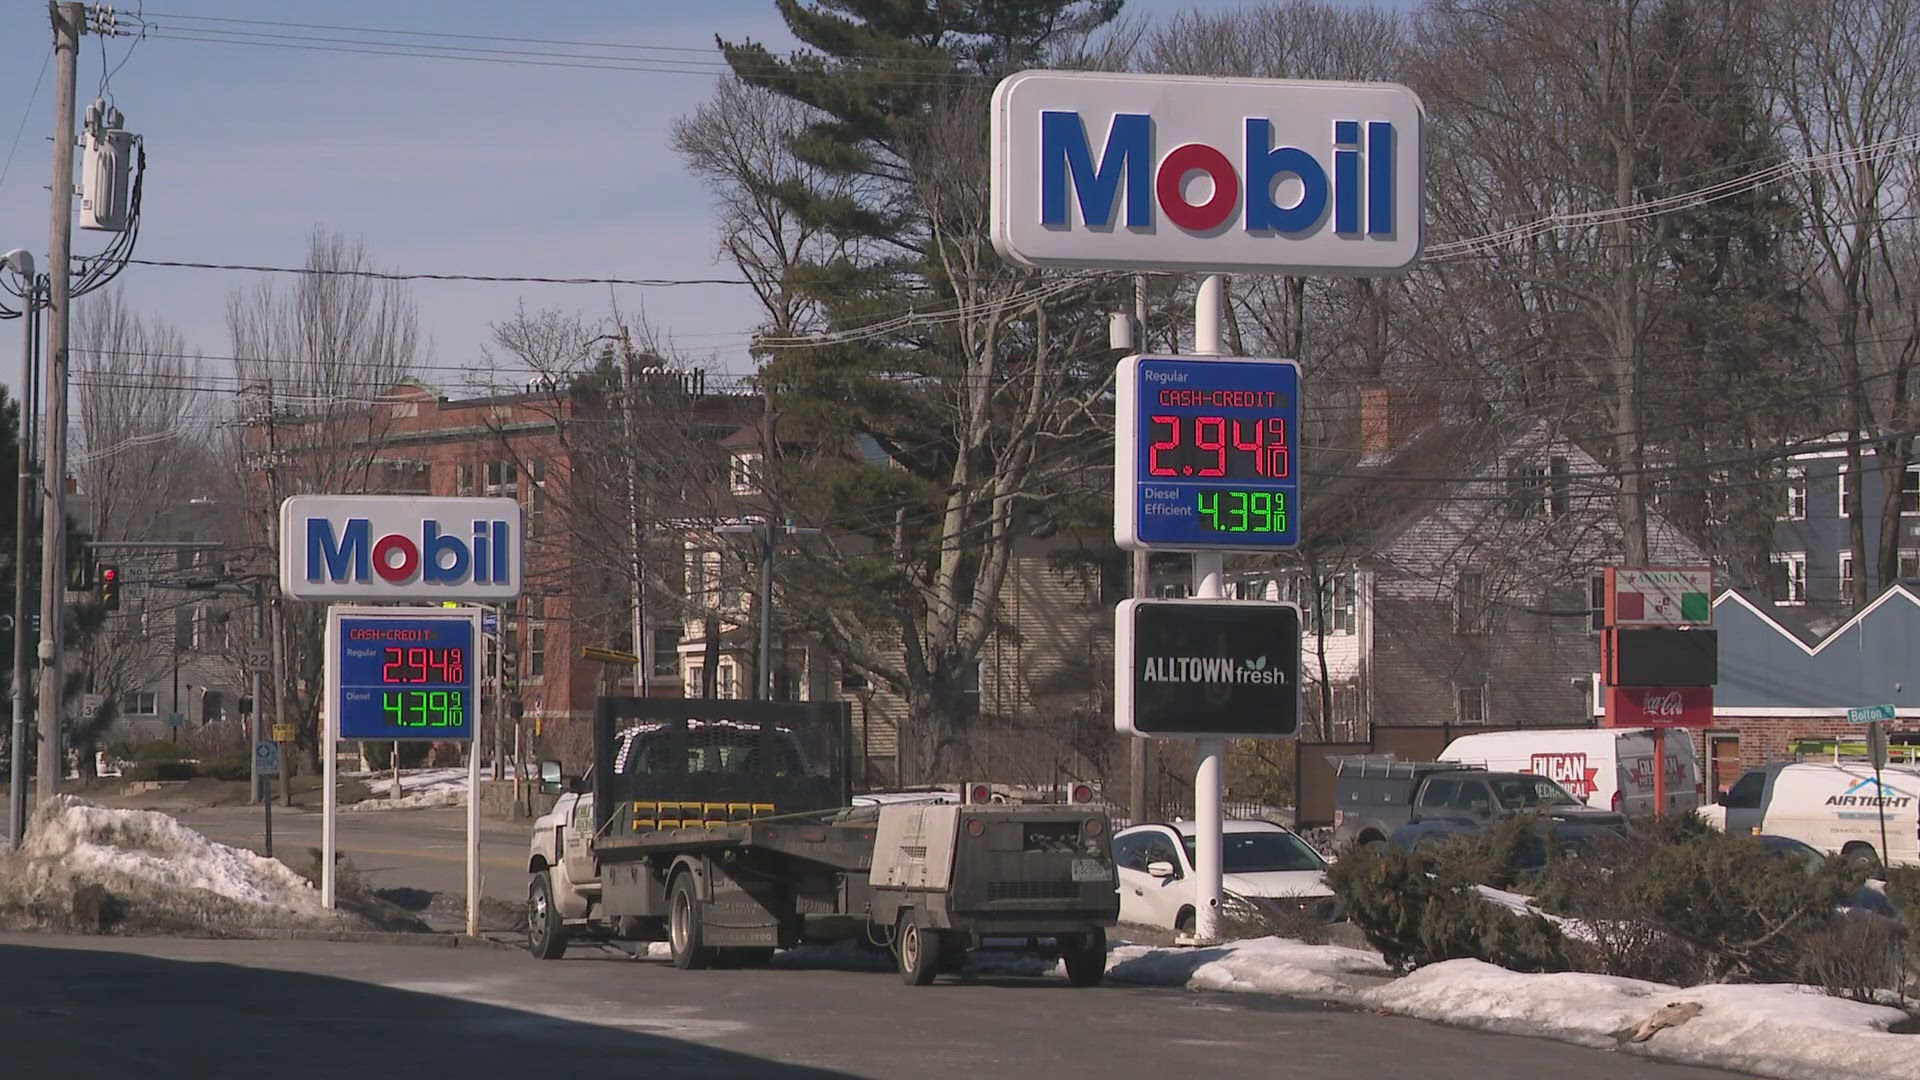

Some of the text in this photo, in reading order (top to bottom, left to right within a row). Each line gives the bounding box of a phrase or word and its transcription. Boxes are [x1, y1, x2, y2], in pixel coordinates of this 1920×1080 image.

[1039, 110, 1397, 240] Mobil
[1145, 370, 1188, 384] Regular
[1159, 390, 1275, 407] CASH-CREDIT
[1145, 489, 1179, 499] Diesel
[1145, 504, 1192, 516] Efficient
[306, 517, 510, 586] Mobil
[350, 629, 431, 641] CASH-CREDIT
[347, 649, 376, 658] Regular
[251, 655, 268, 667] 22
[1144, 657, 1285, 685] ALLTOWN fresh
[346, 692, 370, 701] Diesel
[1851, 708, 1882, 721] Bolton
[1532, 756, 1585, 781] DUGAN
[1640, 758, 1678, 776] DUAN
[1825, 795, 1911, 808] AIRTIGHT
